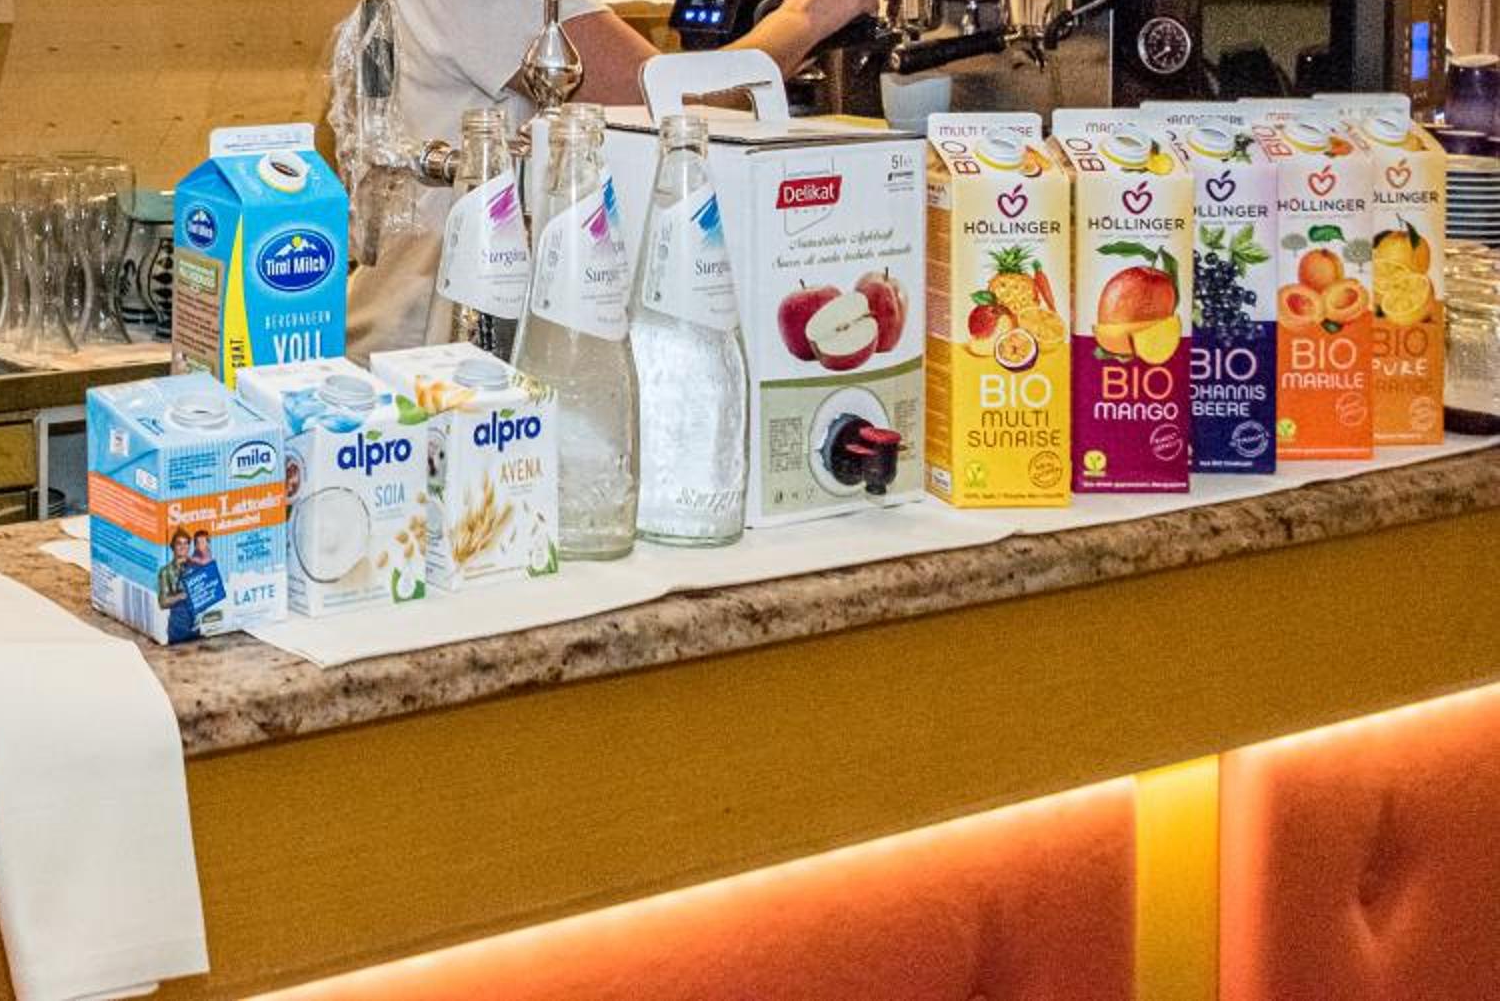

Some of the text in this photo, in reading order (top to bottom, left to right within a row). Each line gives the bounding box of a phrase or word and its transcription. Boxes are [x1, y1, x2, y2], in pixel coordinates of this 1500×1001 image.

[941, 140, 981, 174] BIO
[1066, 138, 1105, 171] BIO
[783, 182, 835, 204] Delikat
[1194, 205, 1268, 218] LLINGER
[1277, 198, 1365, 212] HÖLLINGER
[963, 220, 1061, 235] HÖLLINGER
[1088, 215, 1186, 231] HÖLLINGER
[266, 256, 326, 276] Tirol Milch
[1189, 348, 1257, 380] BIO
[1292, 337, 1357, 370] BIO
[980, 374, 1053, 408] BIO
[1102, 366, 1174, 400] BIO
[1281, 372, 1365, 389] MARILLE
[1189, 384, 1267, 401] OHANNIS
[981, 410, 1049, 428] MULTI
[1094, 402, 1179, 420] MANGO
[1191, 400, 1251, 417] BEERE
[473, 411, 541, 452] alpro
[967, 430, 1061, 448] SUNRISE
[237, 449, 271, 469] mila
[337, 432, 412, 477] alpro
[500, 457, 544, 484] AVENA
[374, 483, 406, 507] SOIA
[234, 583, 276, 606] LATTE
